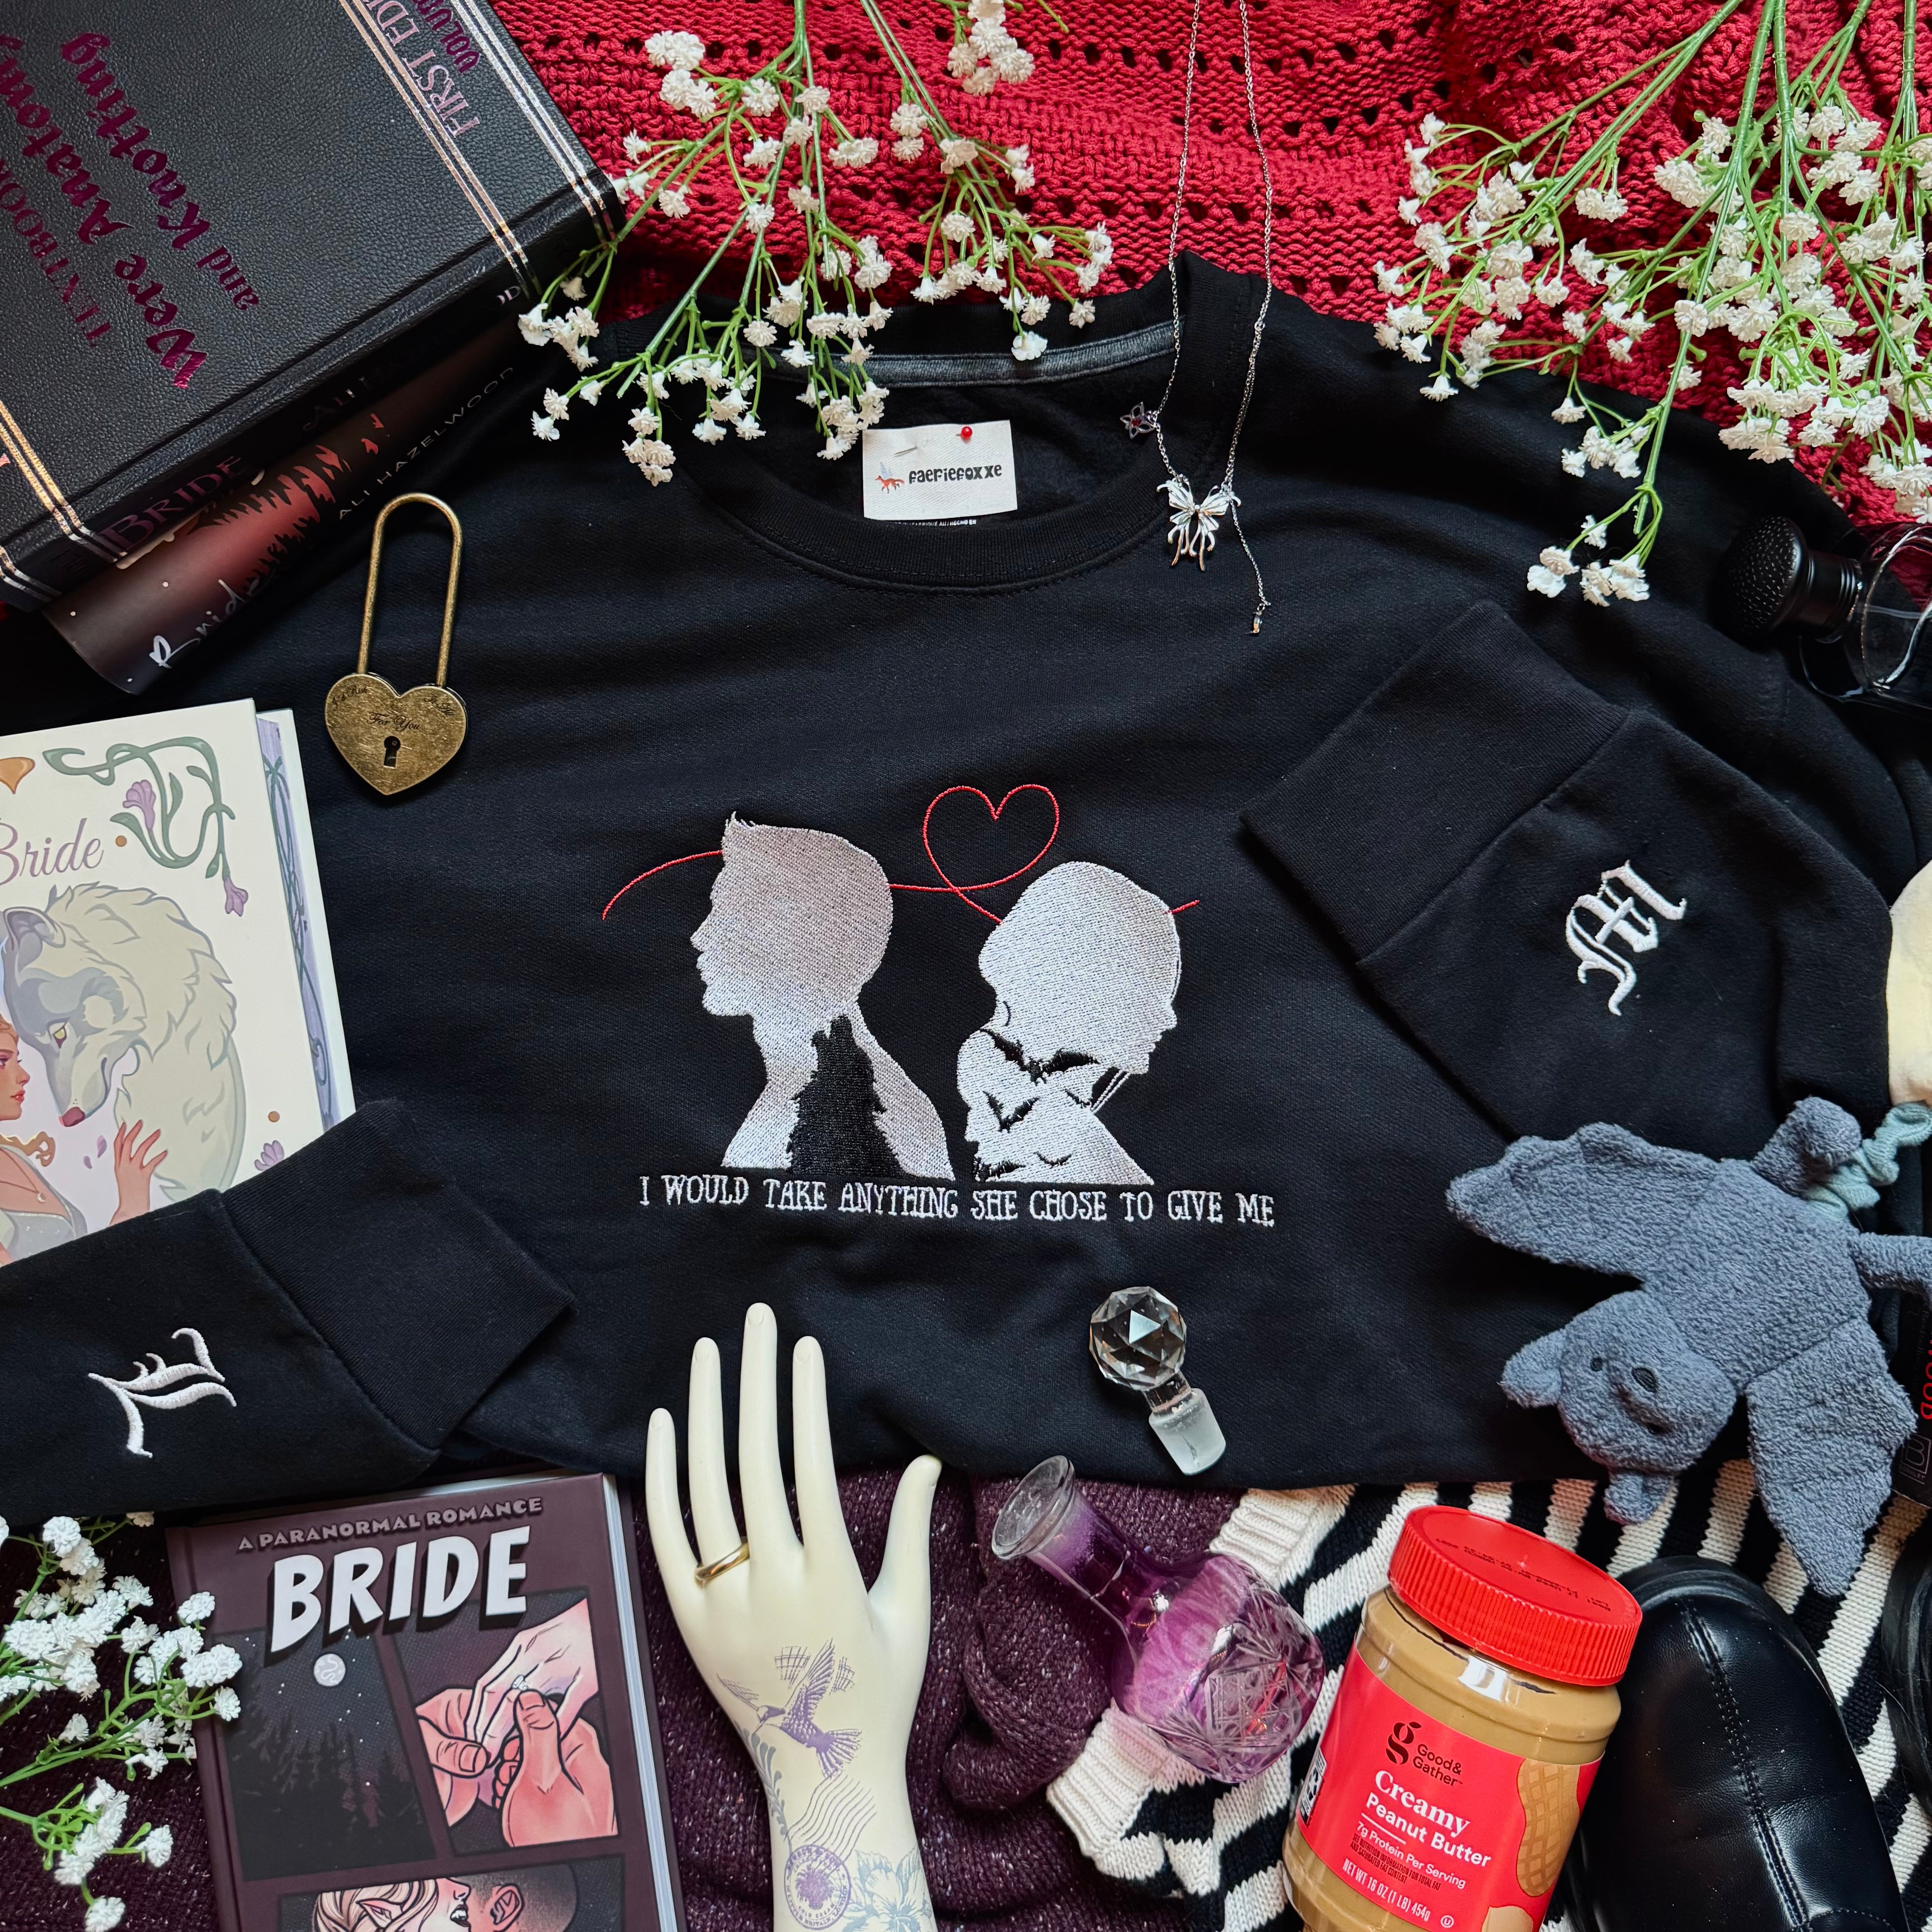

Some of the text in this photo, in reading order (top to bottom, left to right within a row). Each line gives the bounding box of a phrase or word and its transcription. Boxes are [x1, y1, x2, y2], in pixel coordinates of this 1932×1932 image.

[403, 49, 480, 138] FIRST
[61, 33, 259, 311] and Knotting
[0, 159, 111, 347] TEXTBOO
[115, 254, 207, 389] Were
[339, 367, 514, 520] ALI HAZELWOOD
[908, 464, 1003, 484] faeriefoxxe
[102, 456, 242, 550] BRIDE
[366, 711, 421, 732] For You
[639, 1174, 1274, 1227] I WOULD TAKE ANYTHING SHE CHOSE TO GIVE ME
[238, 1497, 543, 1553] A PARANORMAL ROMANCE
[267, 1525, 530, 1658] BRIDE
[1365, 1792, 1491, 1867] Peanut Butter
[1375, 1770, 1471, 1838] Creamy
[1357, 1820, 1466, 1889] 7g Protein Per Serving
[1357, 1845, 1381, 1868] SATURATED
[1379, 1859, 1389, 1872] FAT
[1387, 1867, 1408, 1884] CONTENT
[1358, 1837, 1381, 1858] NUTRITION
[1380, 1849, 1409, 1876] INFORMATION
[1409, 1869, 1419, 1881] FOR
[1418, 1874, 1432, 1888] TOTAL
[1432, 1881, 1441, 1891] FAT
[1342, 1858, 1431, 1921] NET WT 16 OZ (1 LB) 454g
